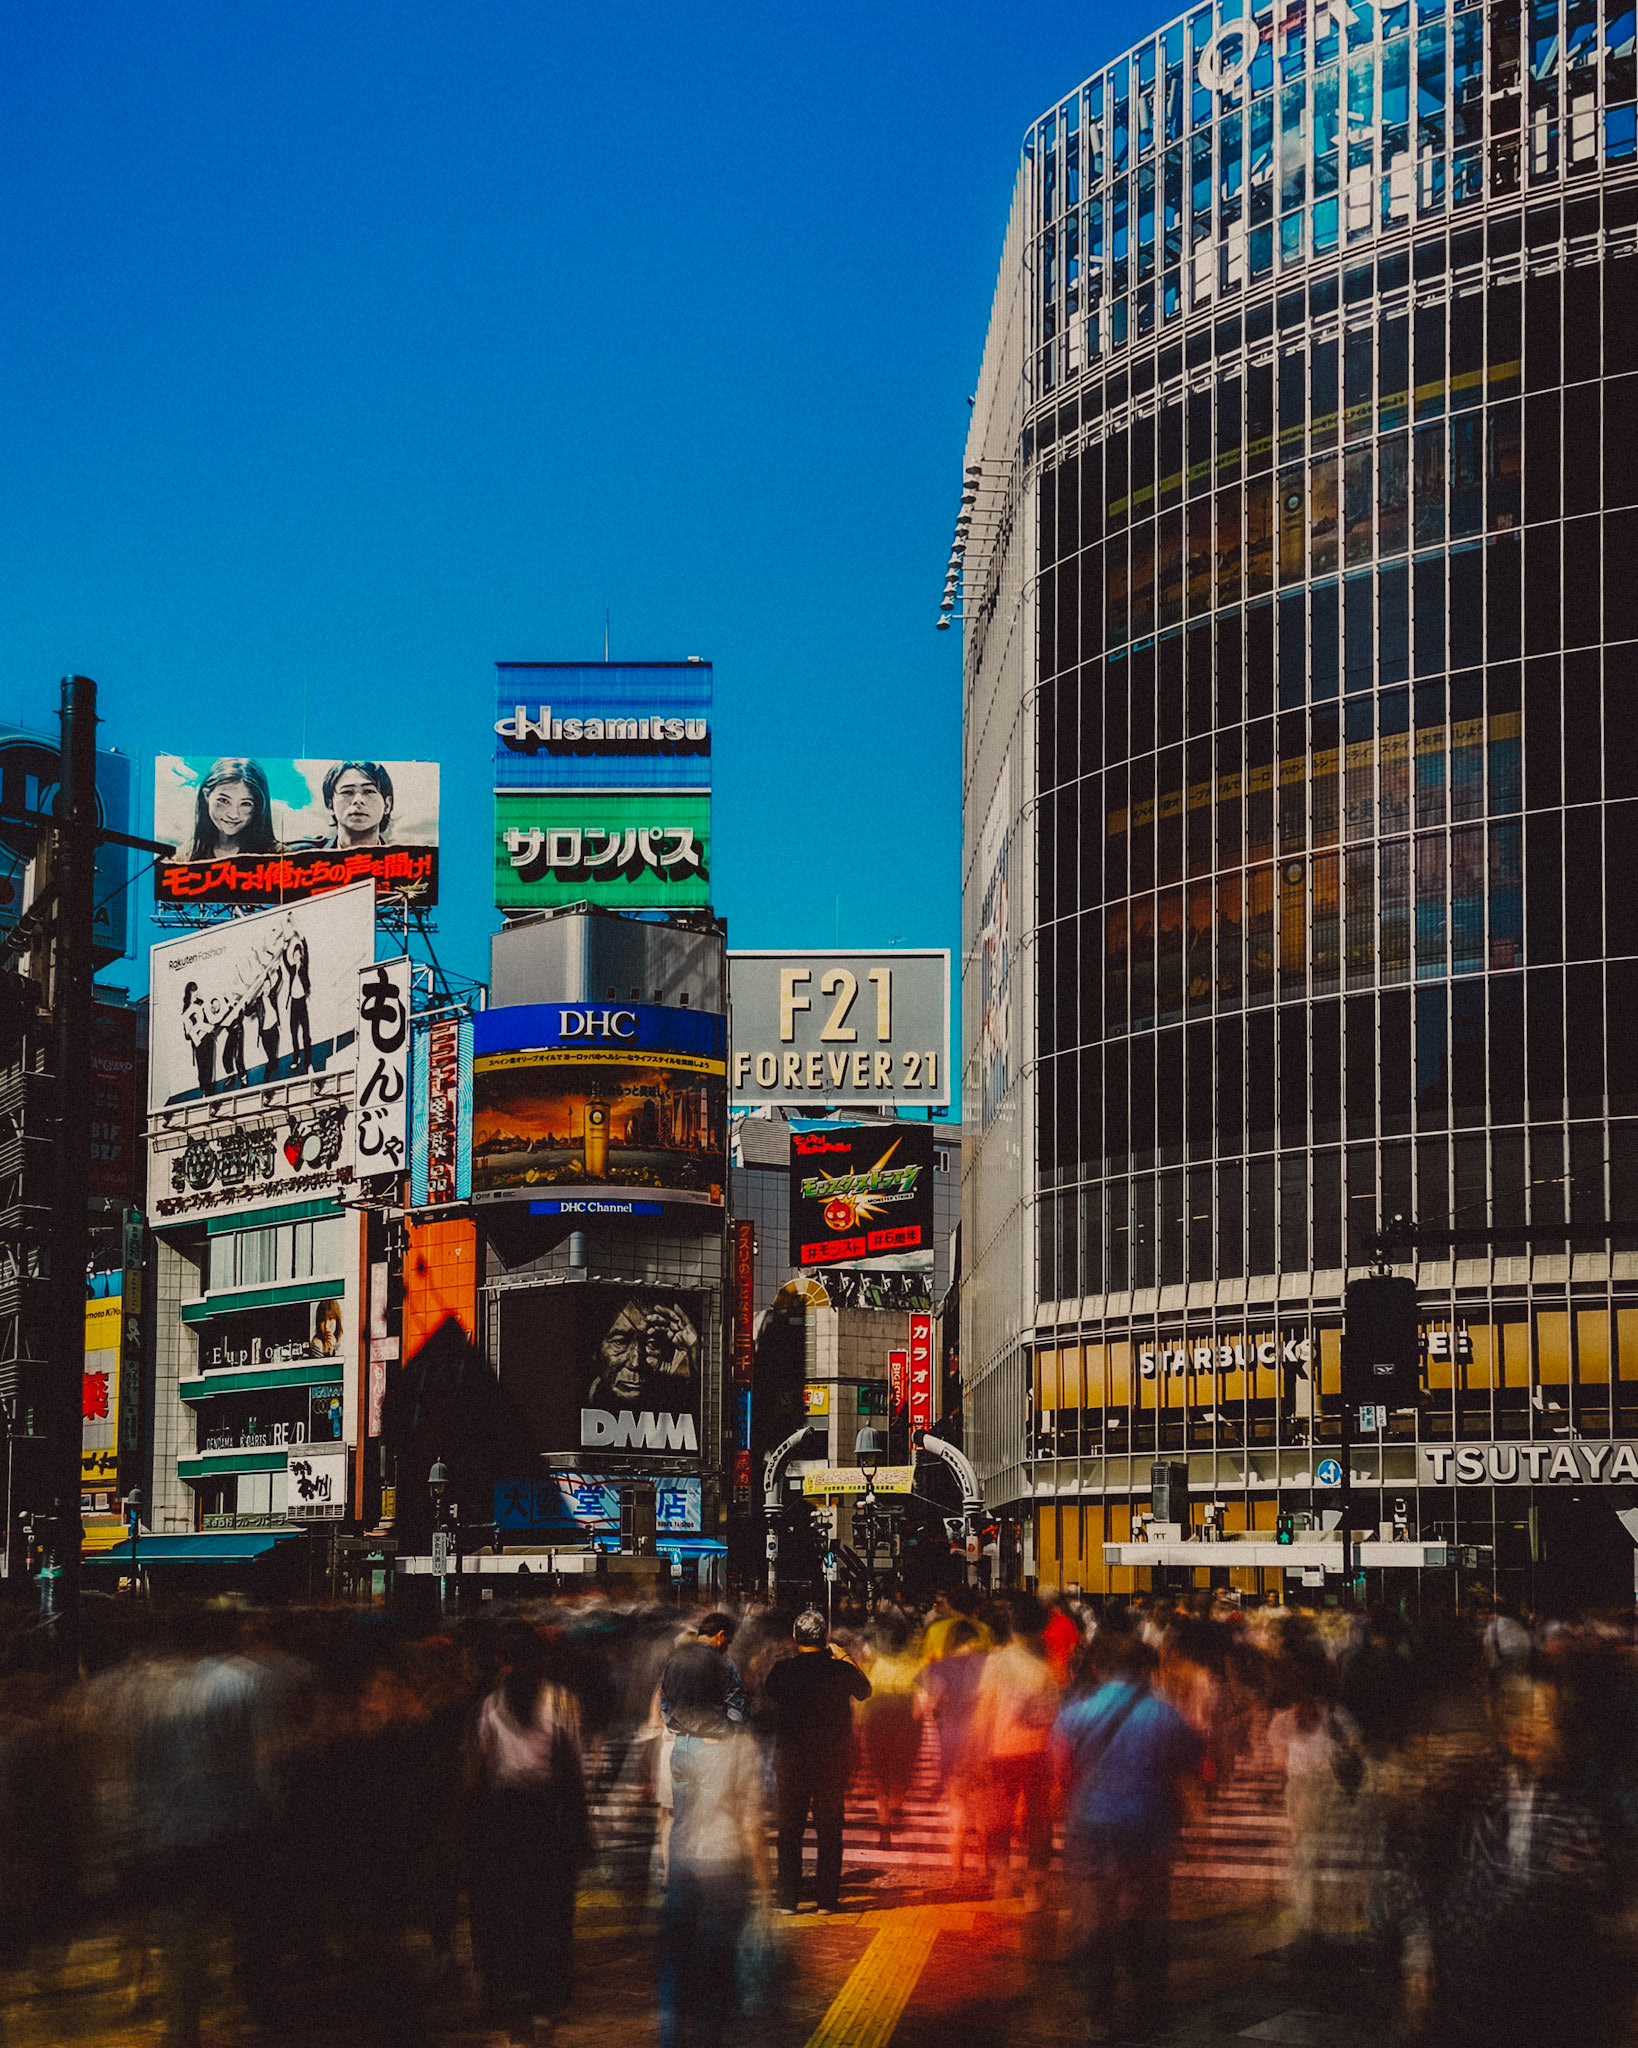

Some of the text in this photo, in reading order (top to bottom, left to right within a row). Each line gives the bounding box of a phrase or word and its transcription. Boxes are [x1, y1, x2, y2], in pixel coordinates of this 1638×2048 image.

[494, 706, 707, 740] Hisamitsu
[503, 827, 699, 867] サロンパス
[168, 945, 227, 971] Rakuten Fashion
[780, 968, 891, 1041] F21
[559, 1010, 635, 1038] DHC
[361, 967, 406, 1167] もんじゃ
[735, 1052, 937, 1087] FOREVER 21
[801, 1164, 923, 1200] モンスターストライク
[560, 1202, 633, 1214] DHC Channel
[808, 1241, 862, 1259] #モンスト
[873, 1230, 917, 1248] #6周年
[912, 1325, 928, 1405] カラオケ
[1140, 1339, 1317, 1374] STARBUCKS
[581, 1408, 698, 1450] DMM
[1426, 1446, 1638, 1481] TSUTAYA
